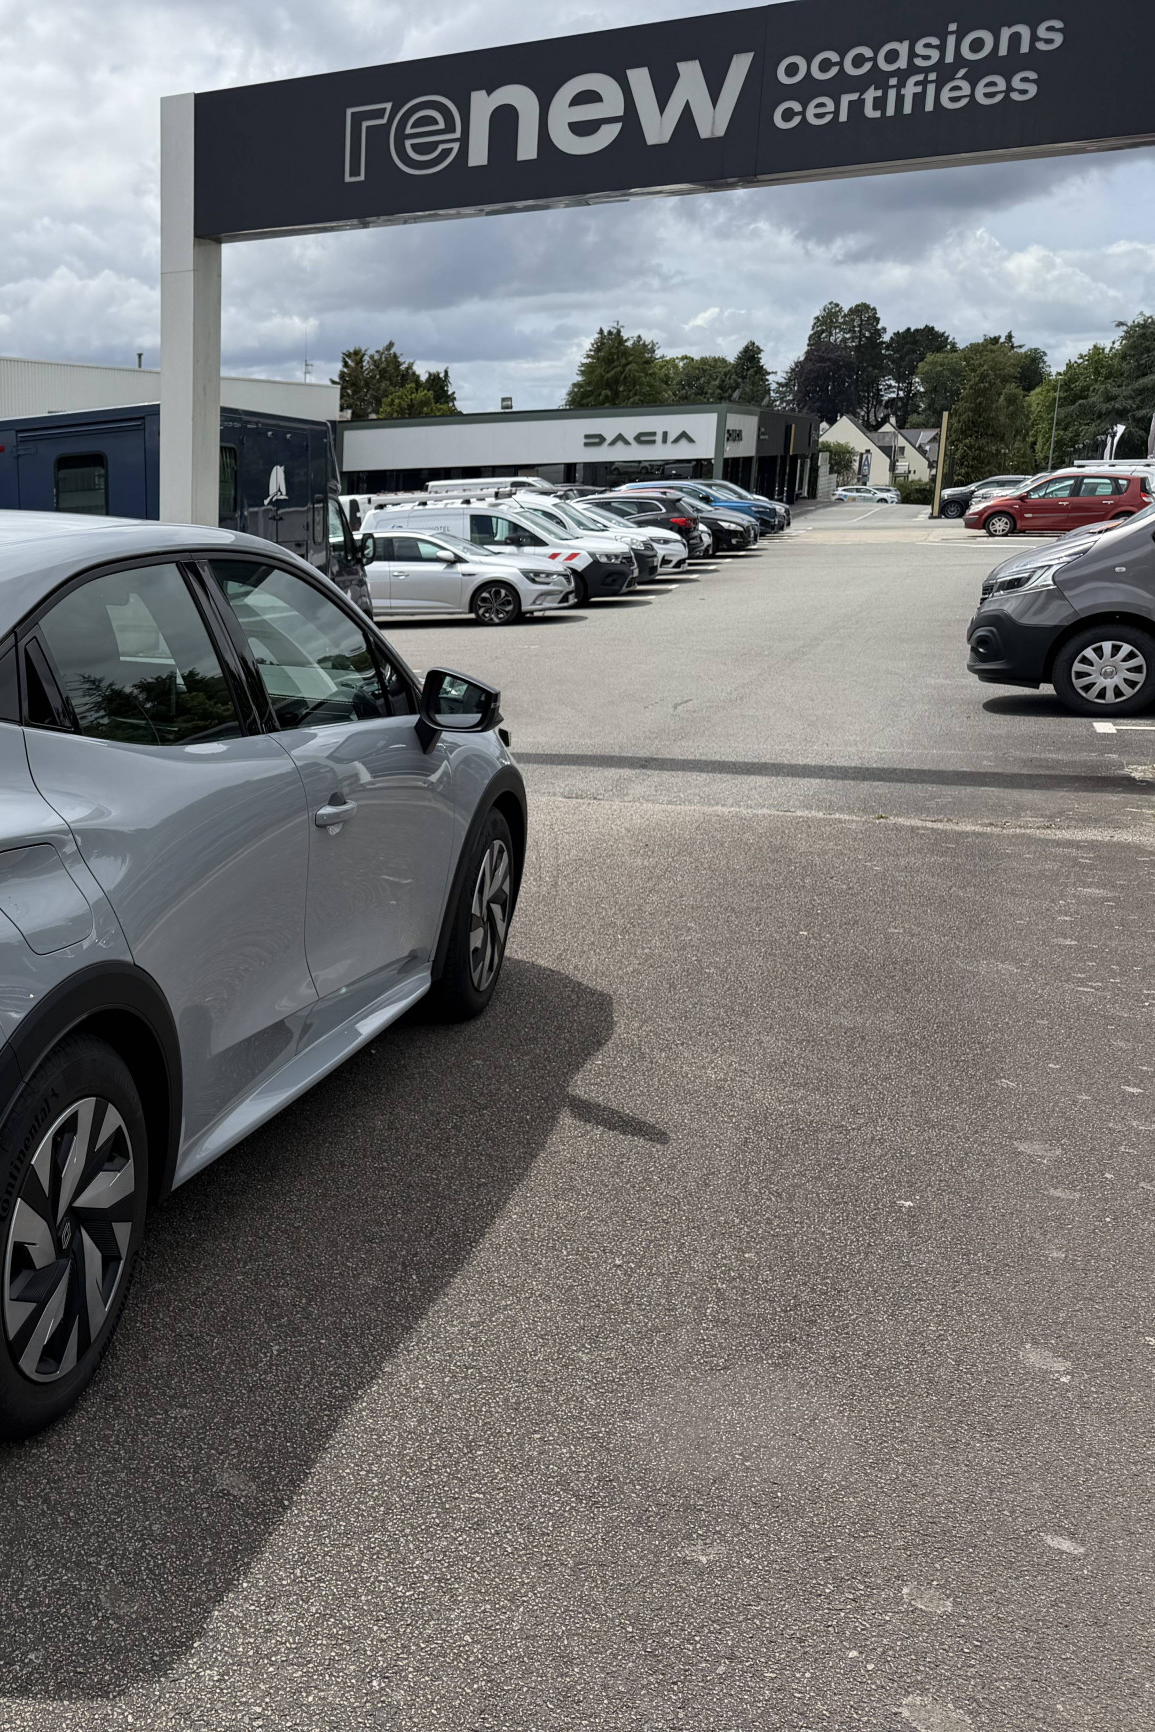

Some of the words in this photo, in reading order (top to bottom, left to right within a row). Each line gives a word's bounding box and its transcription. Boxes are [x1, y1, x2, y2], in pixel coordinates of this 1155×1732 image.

[776, 19, 1065, 85] occasions
[344, 51, 755, 183] renew
[773, 67, 1039, 130] certifiées
[583, 430, 696, 447] DACIA
